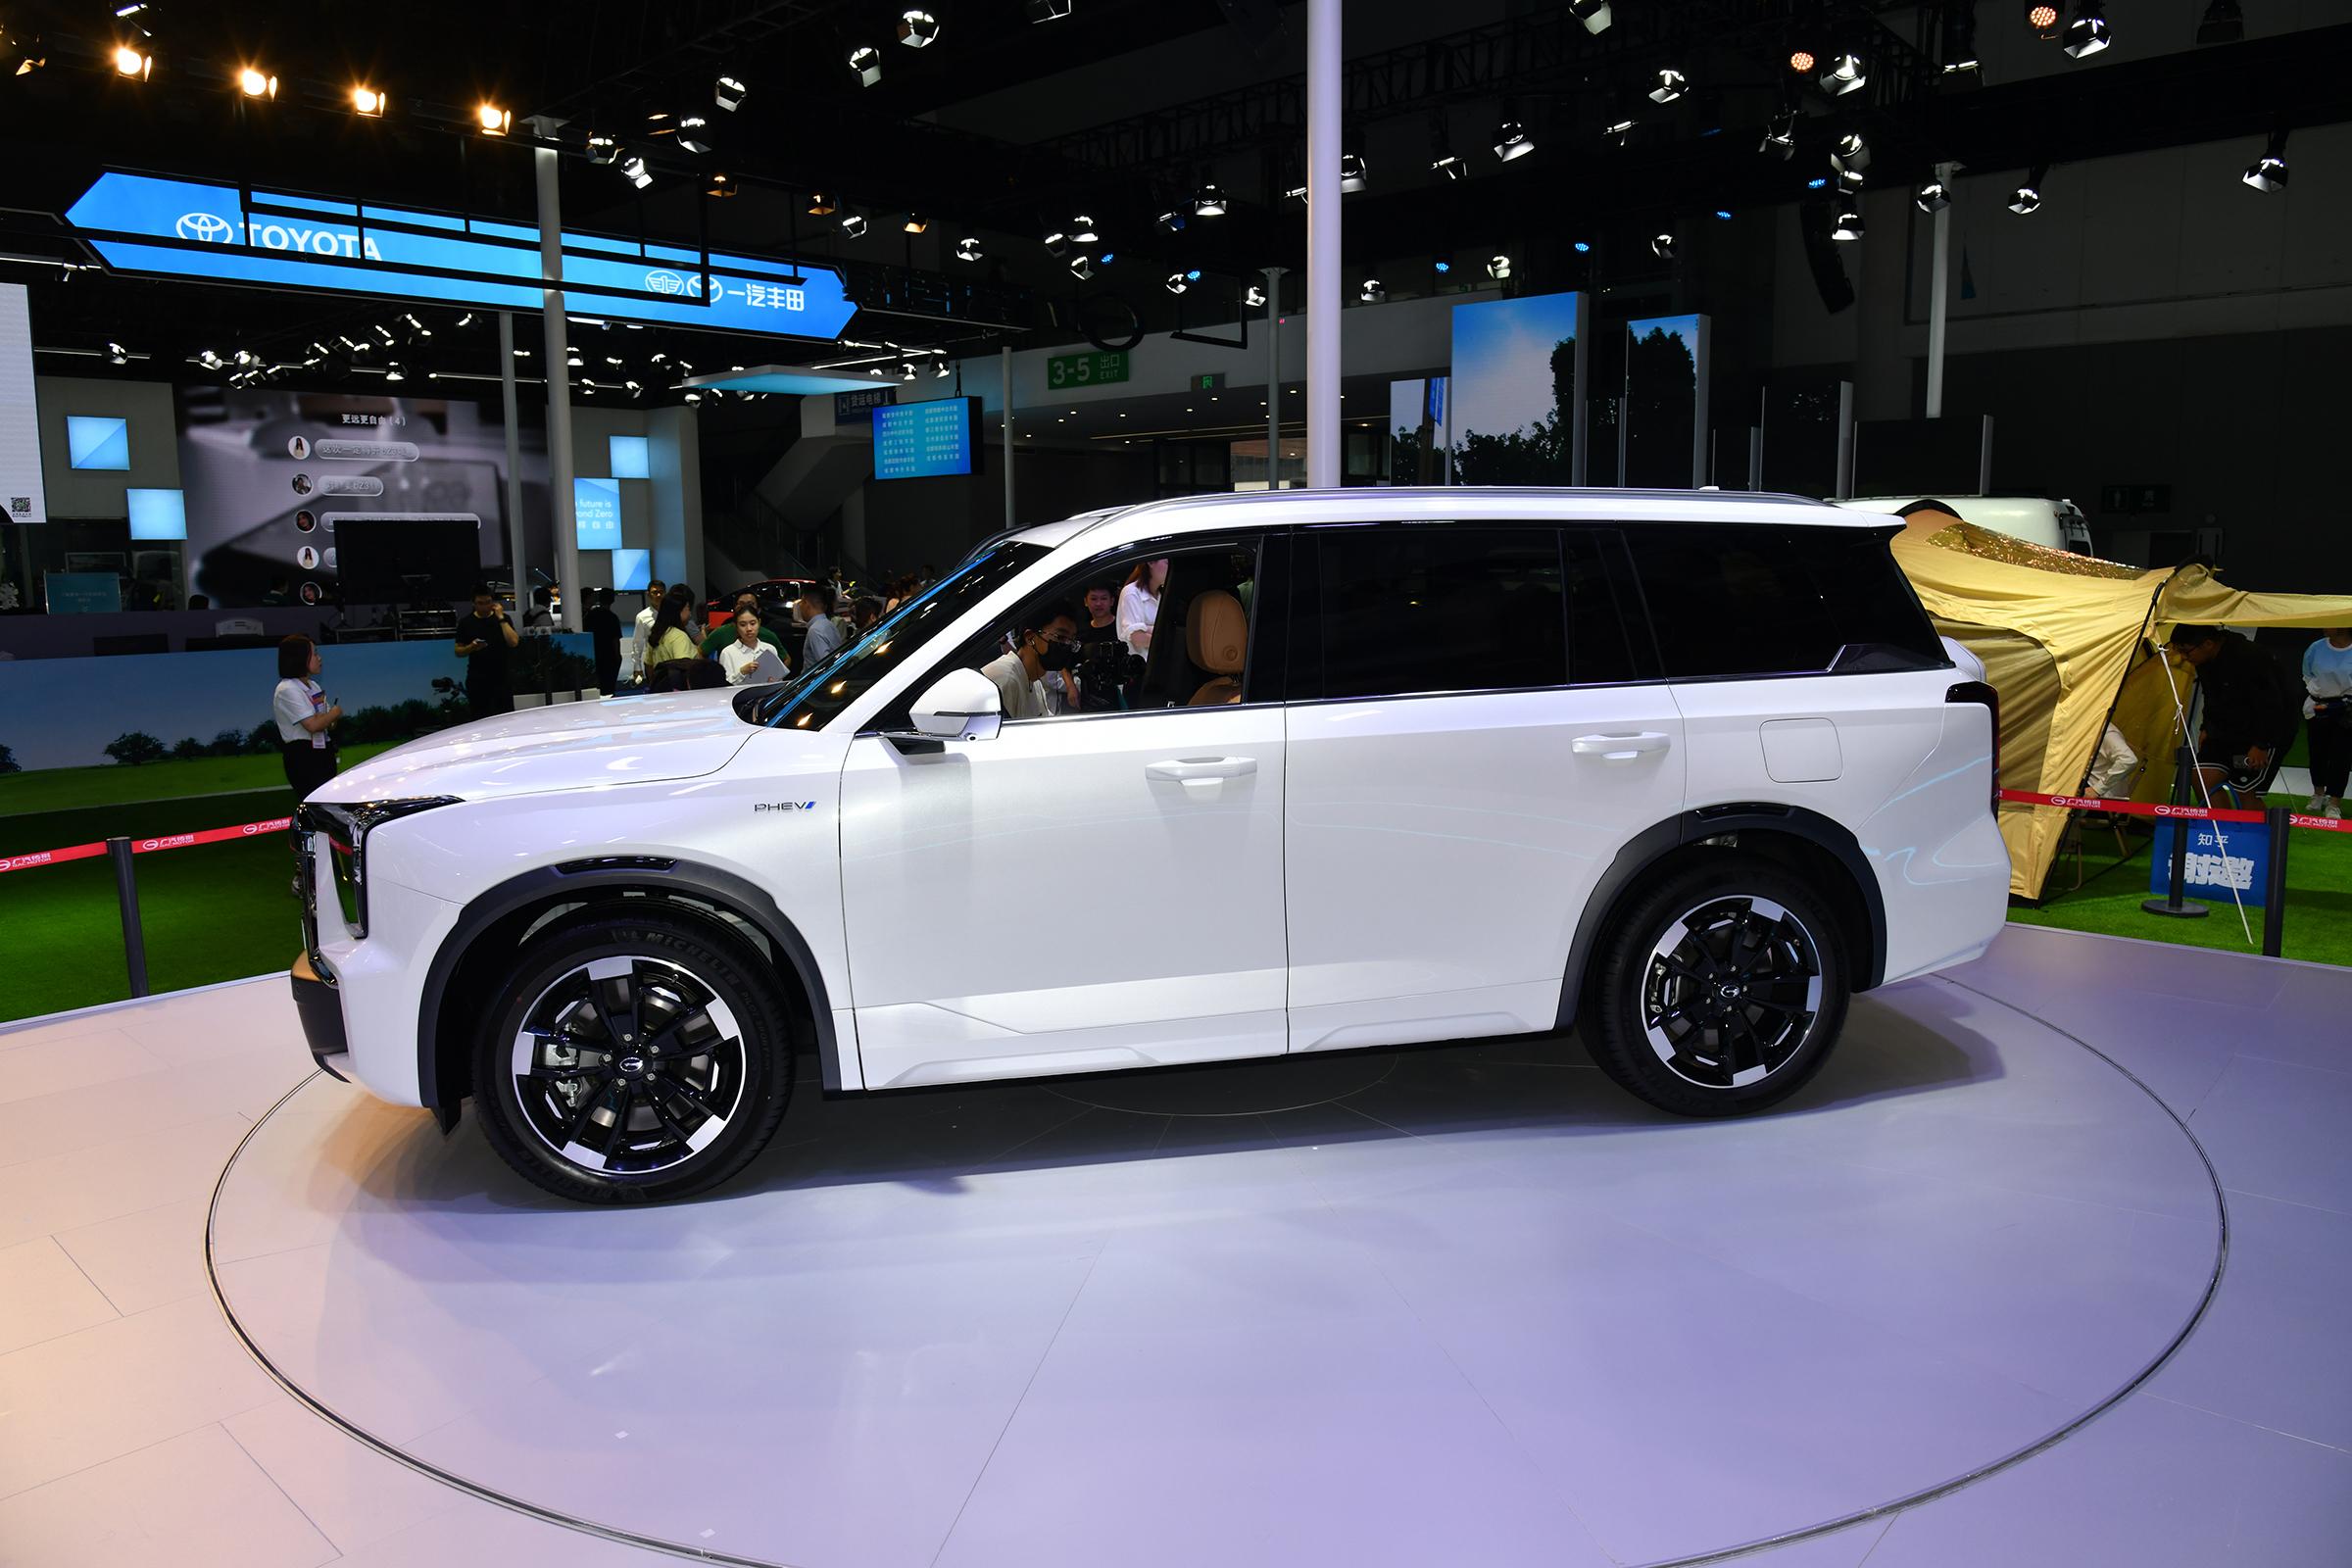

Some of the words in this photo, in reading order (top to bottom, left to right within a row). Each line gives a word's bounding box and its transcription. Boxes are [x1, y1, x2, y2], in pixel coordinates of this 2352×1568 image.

[238, 221, 382, 261] TOYOTA
[727, 282, 805, 312] 一汽丰田
[1100, 354, 1120, 369] 出口
[1053, 357, 1091, 385] 3-5
[1100, 369, 1118, 380] EXIT
[595, 509, 613, 518] Zero
[754, 801, 807, 812] PHEV
[2197, 832, 2230, 848] 知乎
[645, 931, 741, 986] MICHELIN
